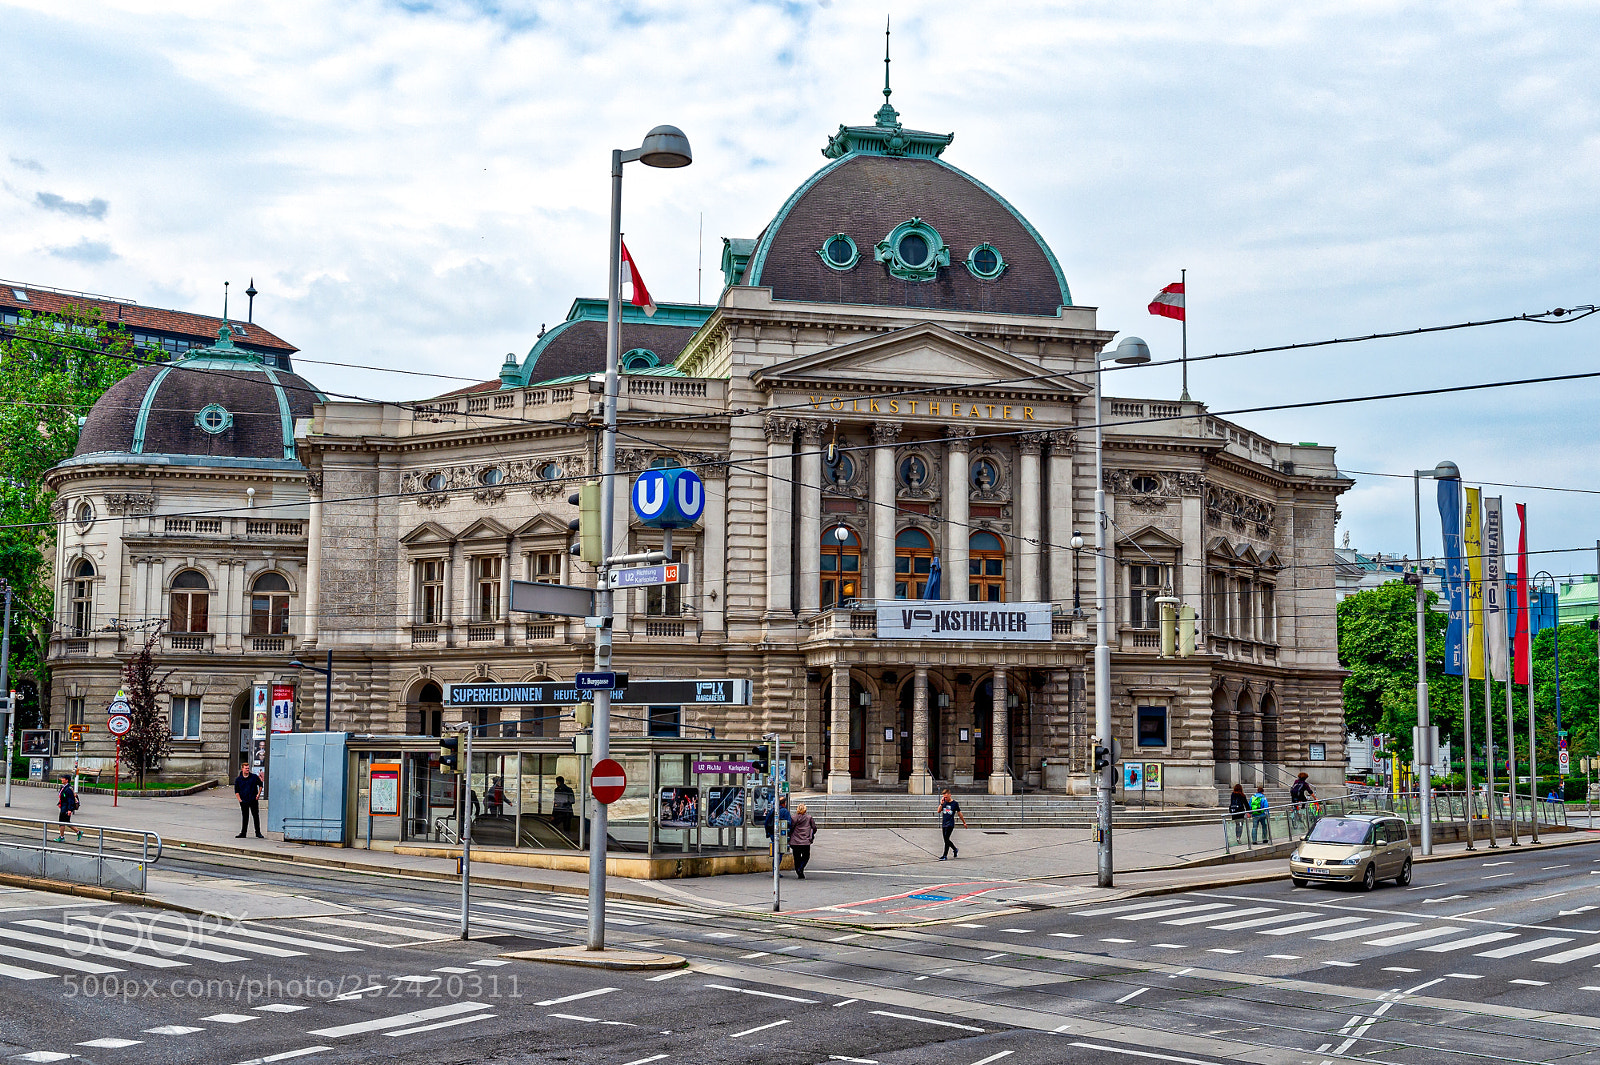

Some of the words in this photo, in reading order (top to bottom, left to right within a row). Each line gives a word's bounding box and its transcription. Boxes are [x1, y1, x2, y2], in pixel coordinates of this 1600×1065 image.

[810, 396, 1035, 420] VOLKSTHEATER
[638, 478, 664, 515] U
[679, 478, 701, 516] U
[625, 573, 635, 582] U2
[666, 569, 677, 579] U3
[453, 687, 543, 702] SUPERHELDINNEN
[553, 688, 580, 701] HEUTE,
